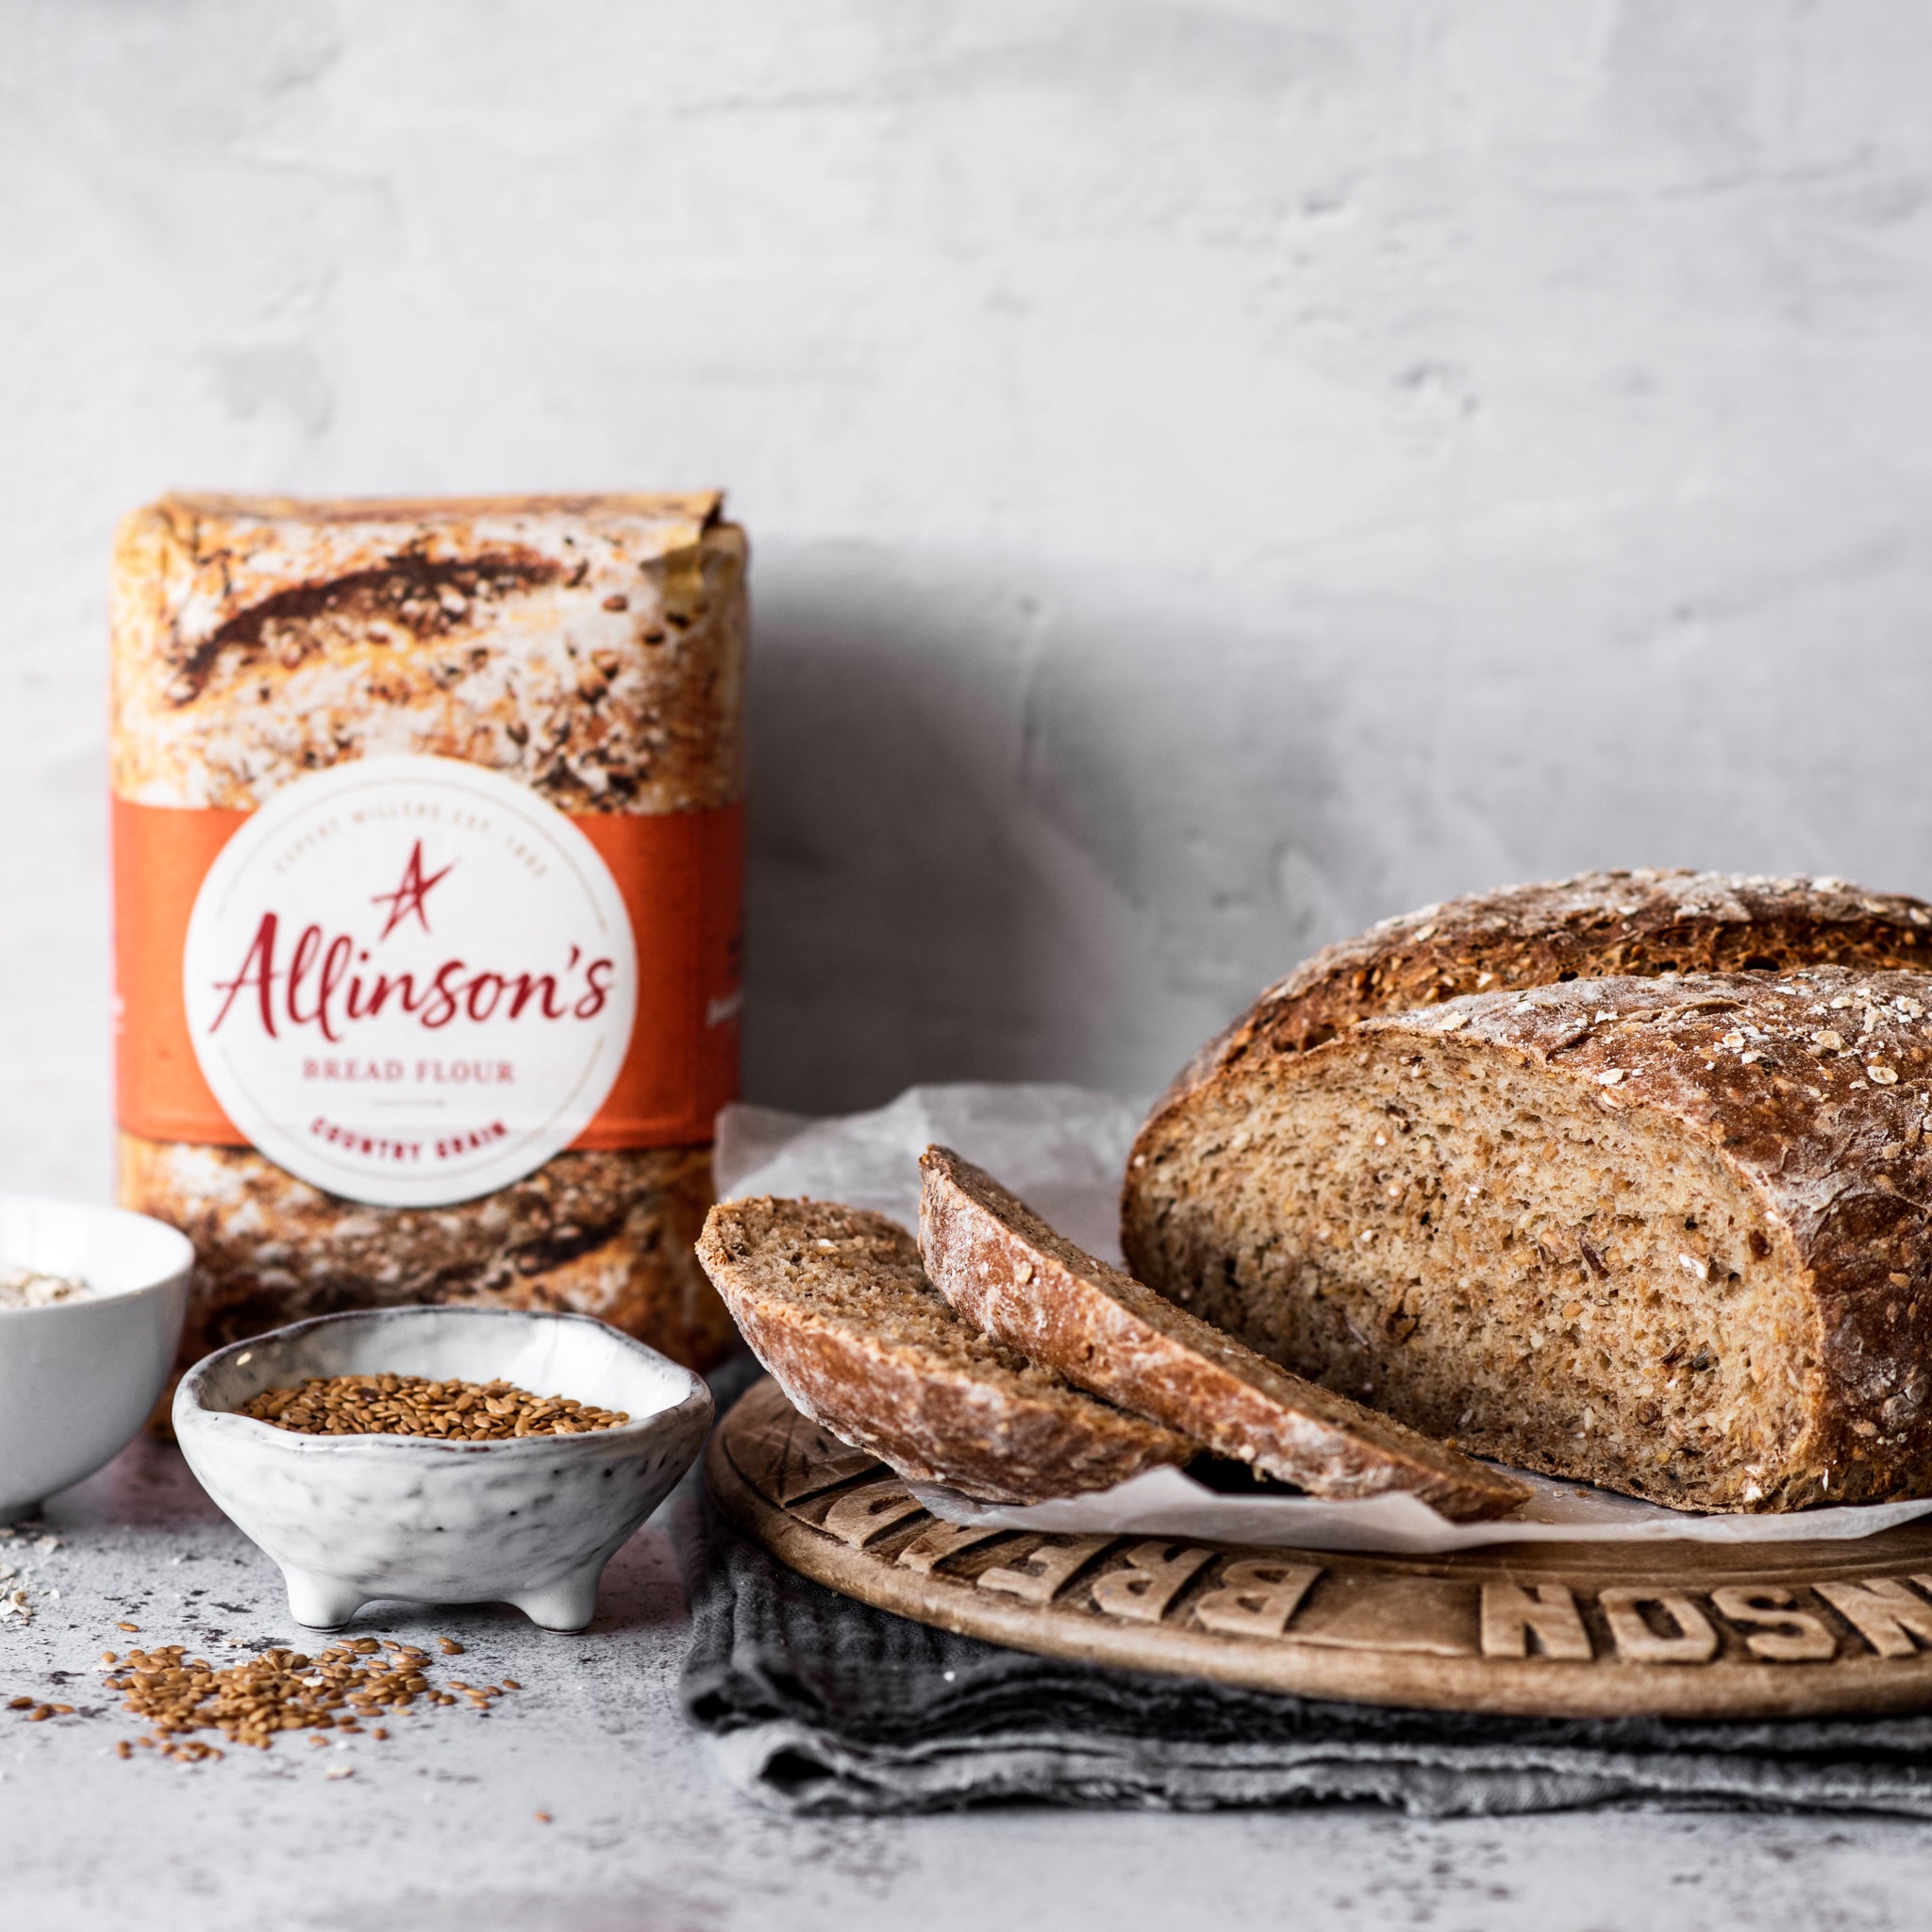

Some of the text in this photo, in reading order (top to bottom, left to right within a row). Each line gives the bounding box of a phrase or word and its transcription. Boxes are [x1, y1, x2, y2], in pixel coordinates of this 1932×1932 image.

[208, 911, 614, 1042] Allinson's
[303, 1059, 513, 1083] BREAD FLOUR
[310, 1116, 508, 1161] COUNTRY GRAIN
[1480, 1573, 1932, 1661] NSON
